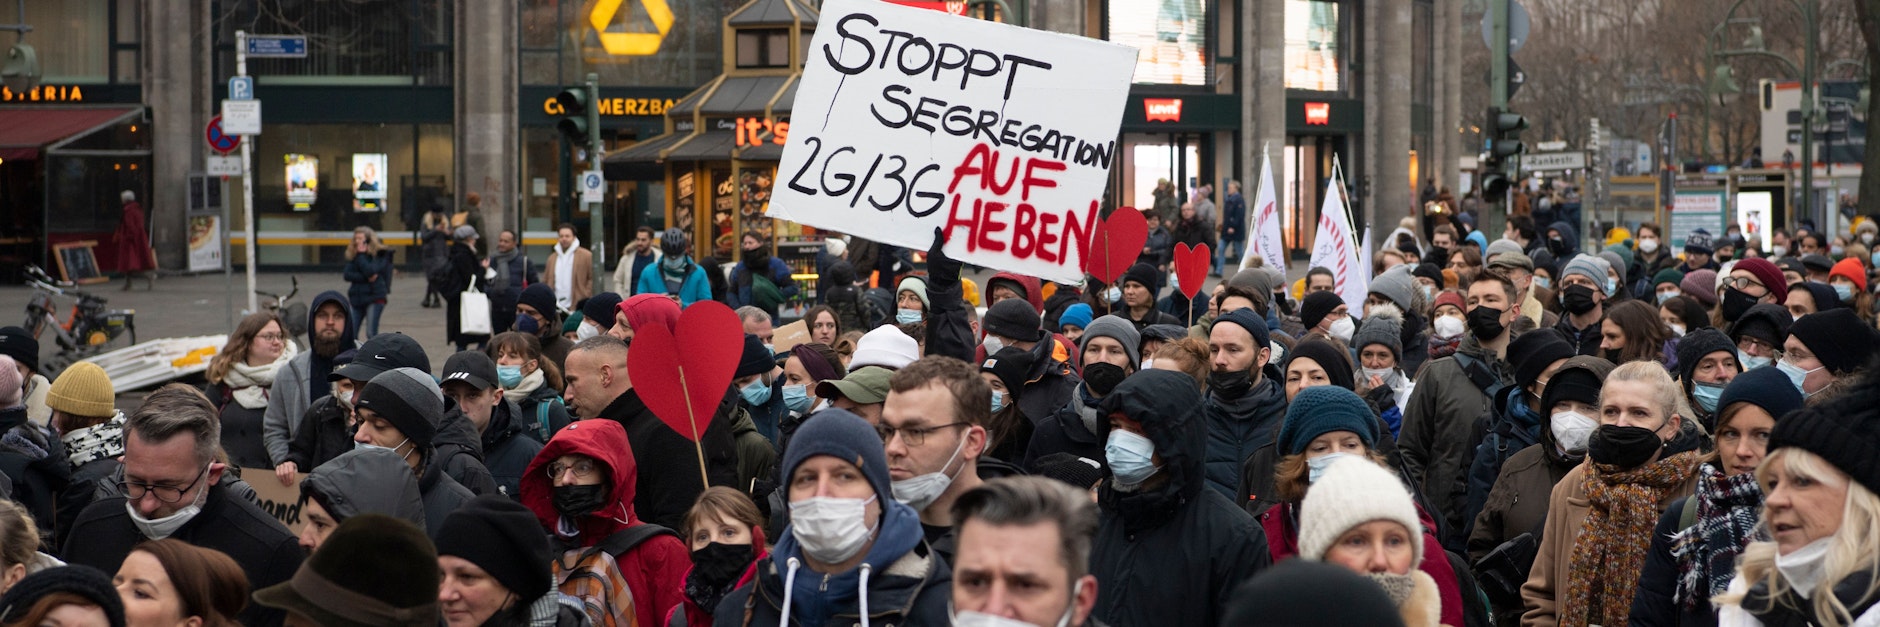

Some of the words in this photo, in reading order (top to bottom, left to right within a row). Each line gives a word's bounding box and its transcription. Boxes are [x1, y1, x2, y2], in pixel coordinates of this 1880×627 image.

[233, 80, 247, 98] P
[823, 13, 1052, 100] STOPPT
[871, 85, 1114, 170] SEGREGATION
[788, 137, 945, 219] 2G/3G
[948, 143, 1067, 202] AUF
[941, 194, 1099, 274] HEBEN
